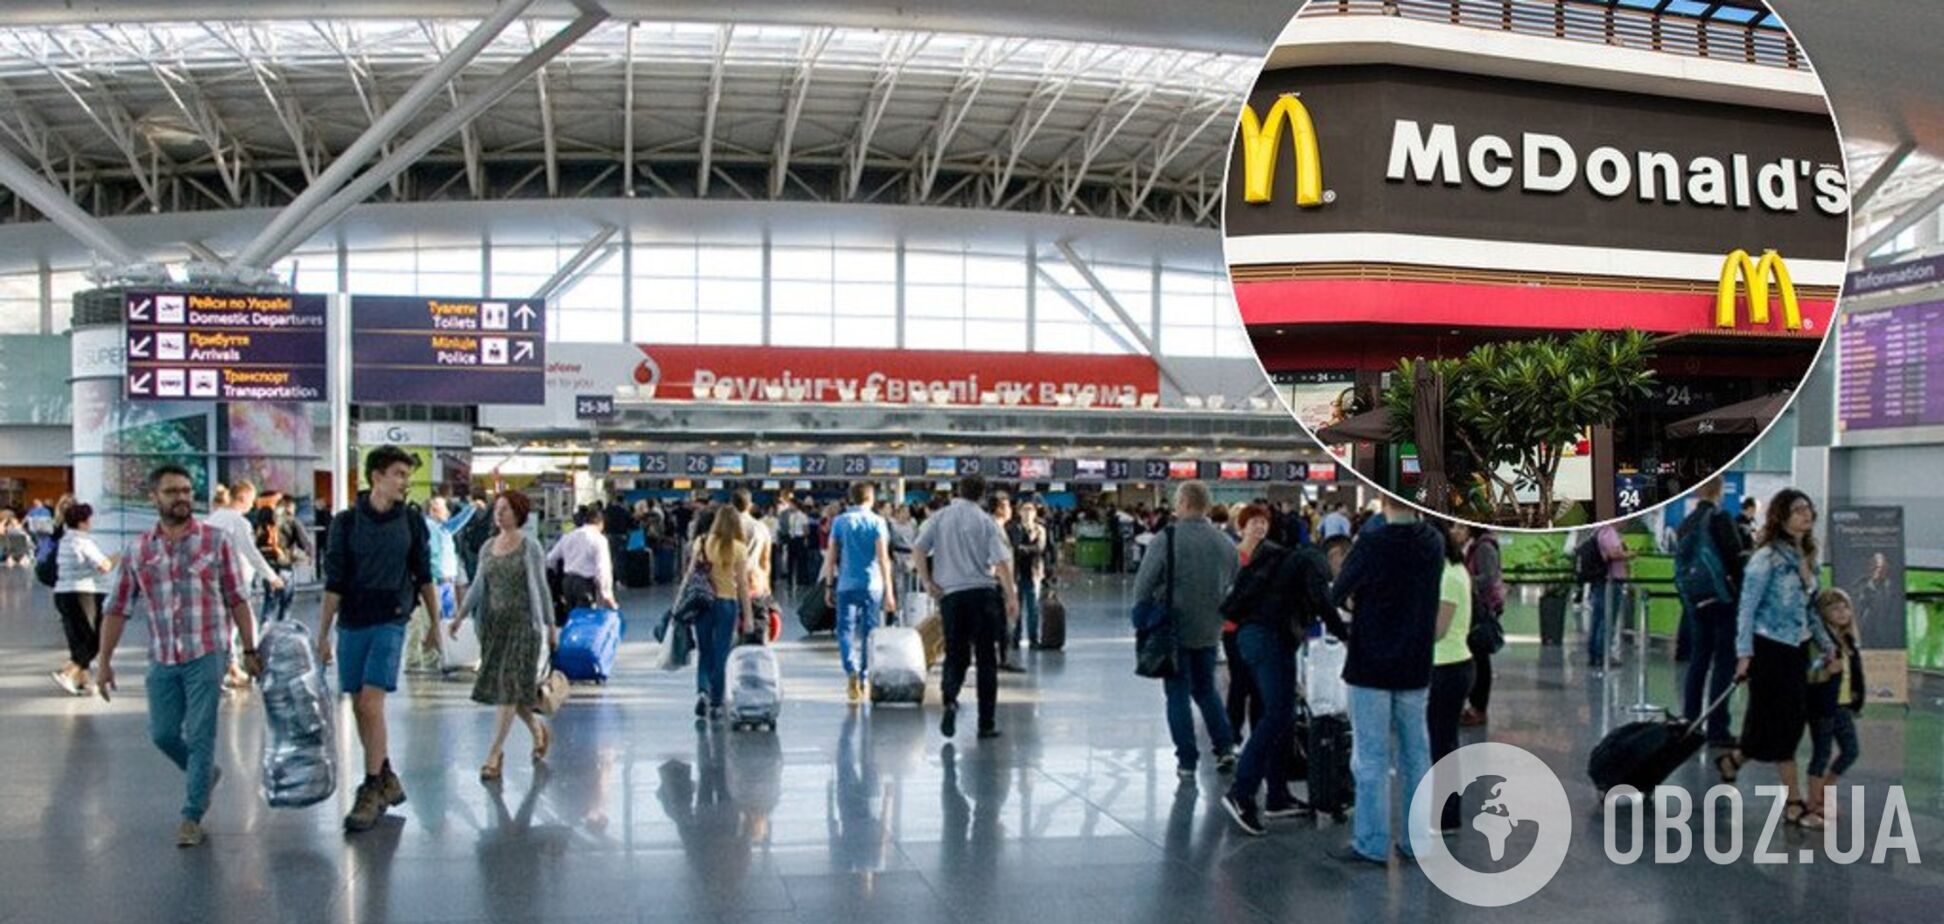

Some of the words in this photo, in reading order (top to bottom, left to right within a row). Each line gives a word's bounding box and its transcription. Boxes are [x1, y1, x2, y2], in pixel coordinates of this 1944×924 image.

[1385, 119, 1849, 215] McDonald's
[1854, 264, 1935, 289] Information
[189, 296, 227, 310] Рейси
[230, 299, 246, 310] по
[428, 301, 477, 316] Туалети
[189, 313, 249, 325] Domestic
[252, 313, 323, 328] Departures
[433, 316, 477, 329] Toilets
[189, 333, 250, 348] Прибуття
[431, 336, 477, 351] Міліція
[190, 348, 241, 361] Arrivals
[437, 351, 477, 365] Police
[224, 368, 289, 385] Транспорт
[224, 385, 318, 400] Transportation
[1666, 385, 1691, 405] 24
[645, 456, 666, 472] 25
[687, 456, 708, 472] 26
[806, 457, 826, 473] 27
[845, 458, 865, 473] 28
[960, 459, 980, 474] 29
[1000, 460, 1018, 475] 30
[1111, 462, 1128, 475] 31
[1147, 462, 1166, 475] 32
[1252, 463, 1271, 477] 33
[1287, 463, 1306, 478] 34
[1618, 490, 1641, 508] 24
